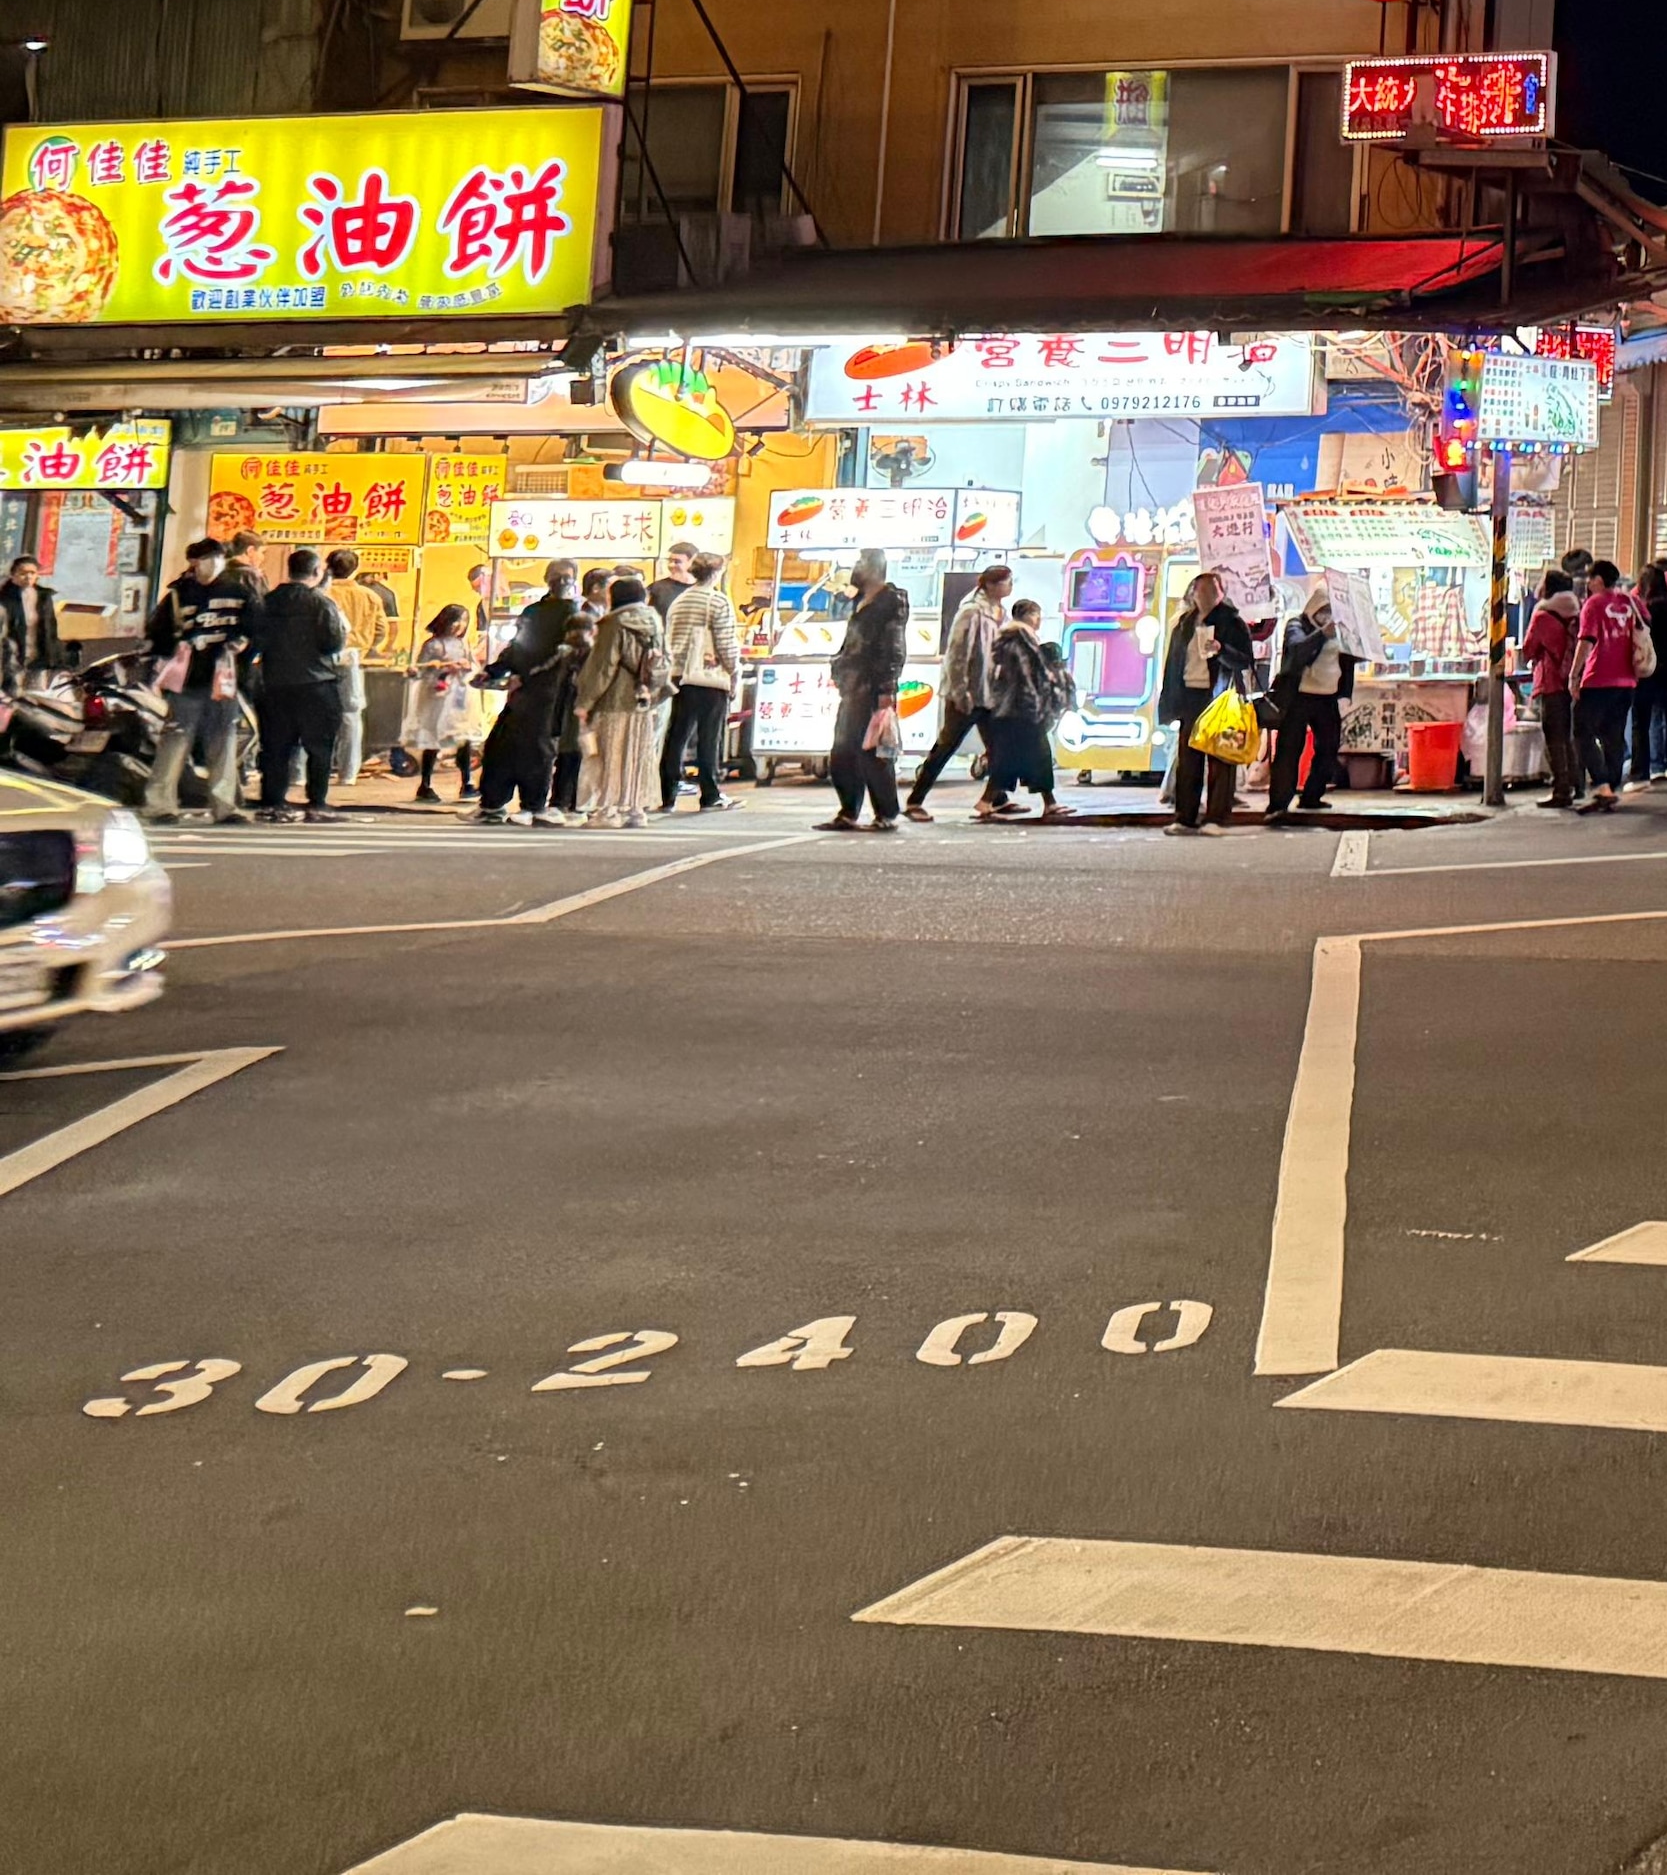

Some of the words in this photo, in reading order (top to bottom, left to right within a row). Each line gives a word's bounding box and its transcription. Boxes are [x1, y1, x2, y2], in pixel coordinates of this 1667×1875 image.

[35, 141, 172, 188] 何佳佳
[184, 150, 242, 174] 純手工
[852, 381, 938, 413] 士林
[1101, 395, 1201, 410] 0979212176
[0, 442, 153, 484] 油餅
[242, 457, 301, 480] 何佳佳
[548, 510, 654, 541] 地瓜球
